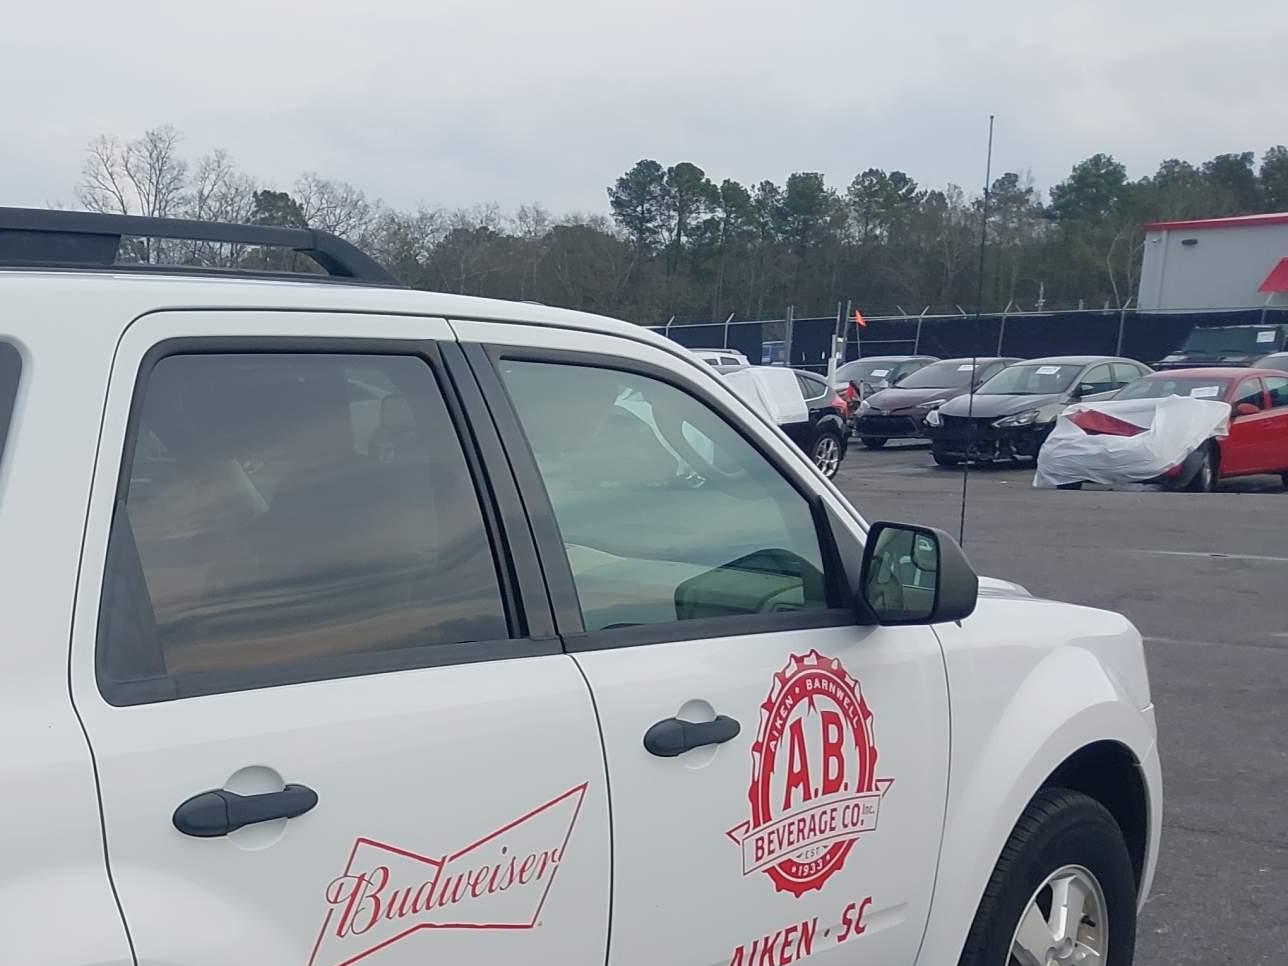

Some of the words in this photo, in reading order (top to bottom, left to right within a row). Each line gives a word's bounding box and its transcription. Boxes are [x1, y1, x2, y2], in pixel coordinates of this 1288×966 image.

[768, 695, 794, 752] AIKEN
[805, 678, 859, 730] BARNWELL
[781, 711, 849, 812] A.B.
[754, 806, 838, 863] BEVERAGE
[841, 802, 865, 829] CO.
[804, 846, 821, 860] EST
[326, 846, 562, 938] Budweiser
[797, 859, 824, 877] 1933
[836, 895, 873, 943] SC
